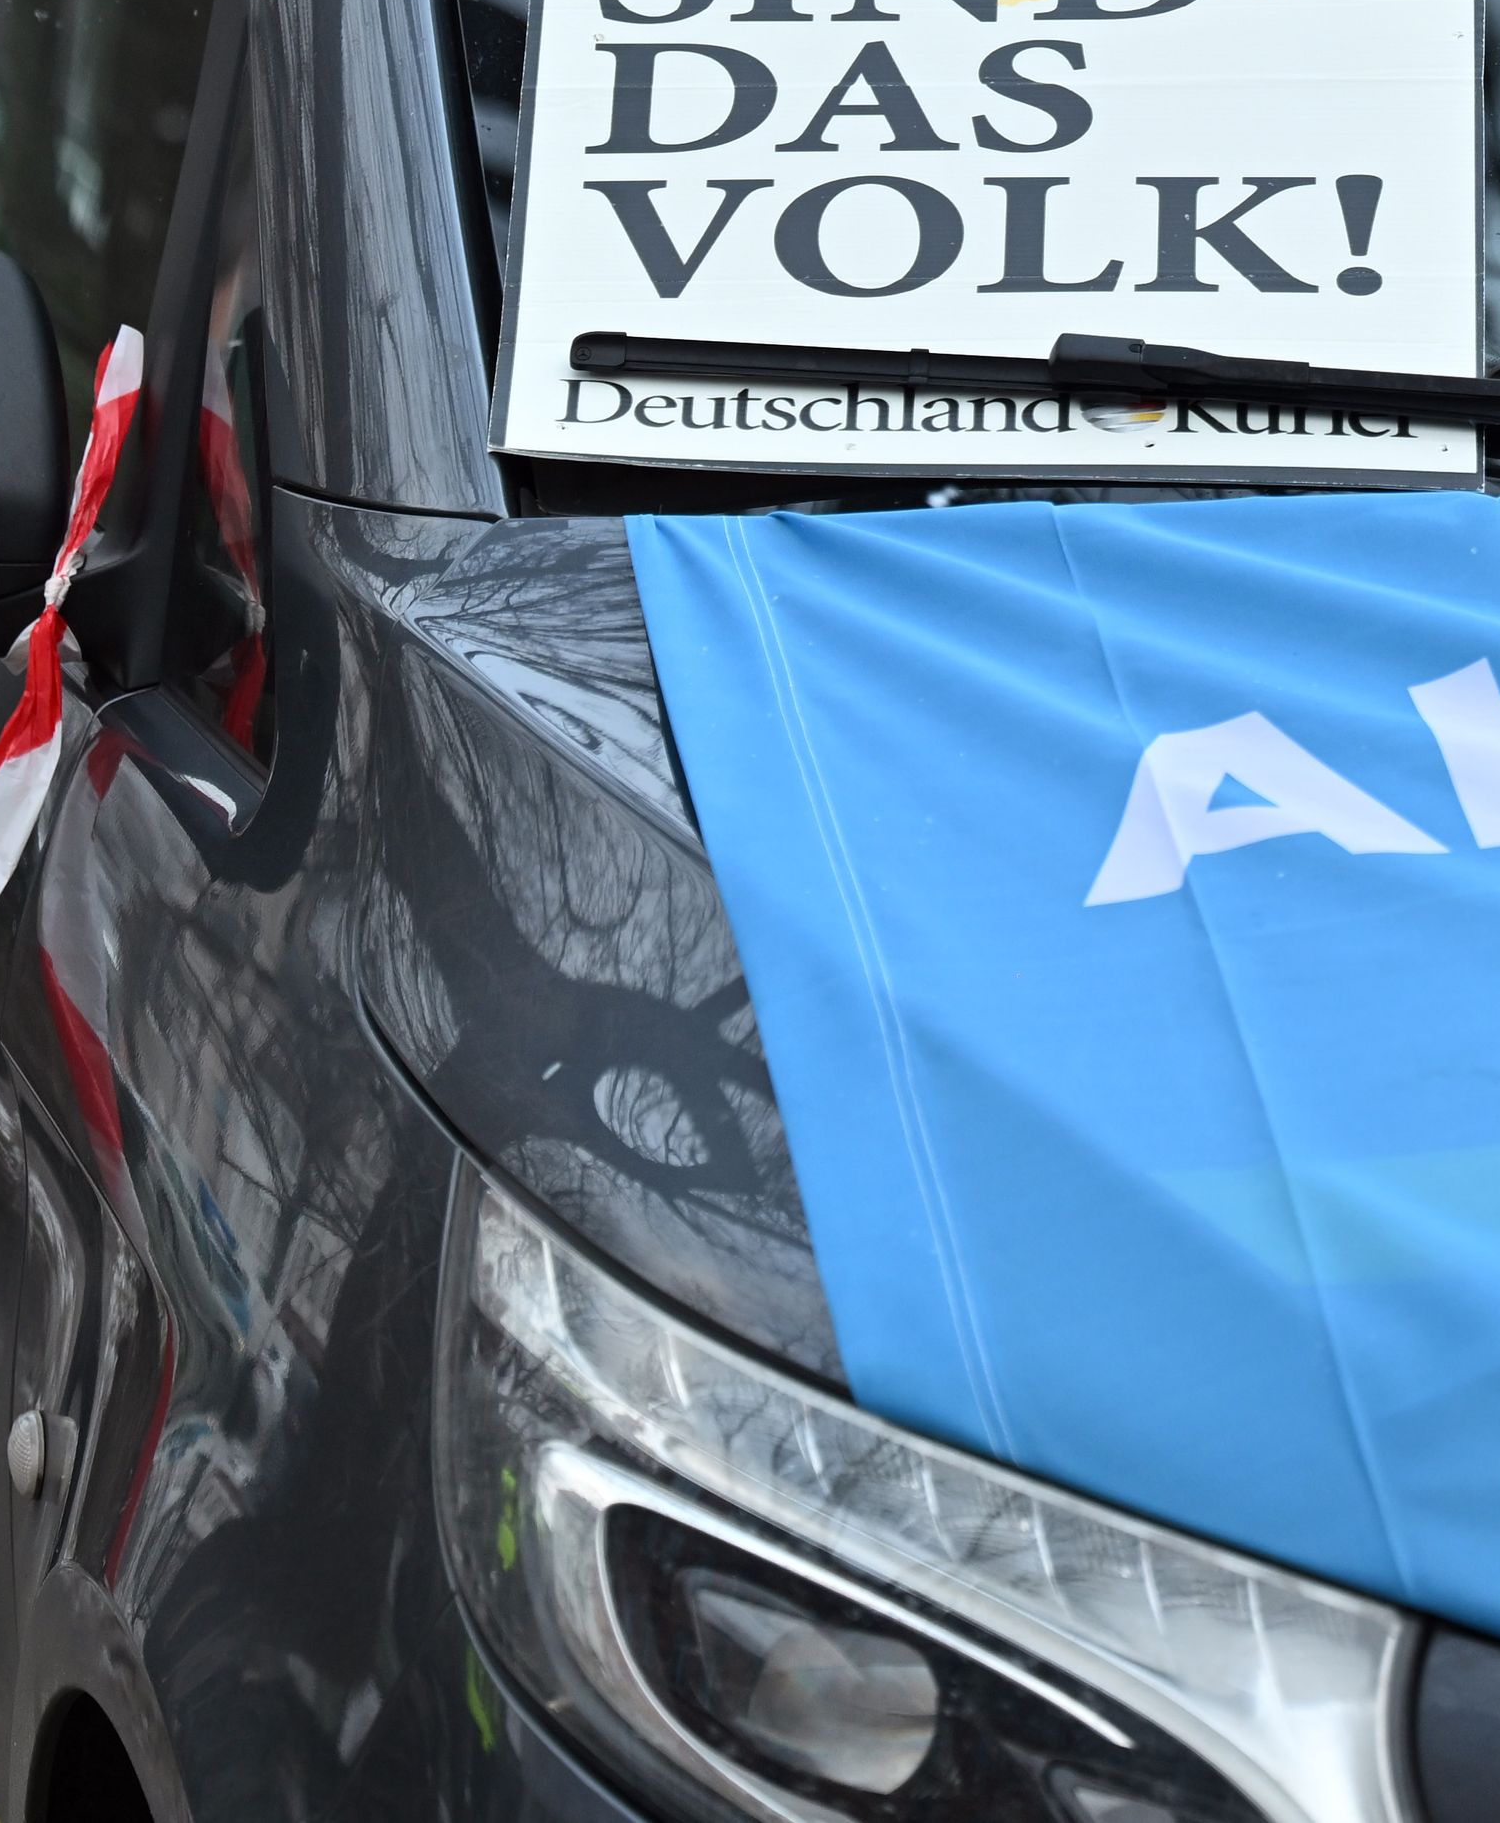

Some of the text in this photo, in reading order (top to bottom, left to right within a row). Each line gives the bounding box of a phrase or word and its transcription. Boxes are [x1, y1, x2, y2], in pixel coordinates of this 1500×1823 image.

[584, 38, 1094, 155] DAS
[582, 173, 1383, 298] VOLK!
[556, 378, 1077, 434] Deutschland
